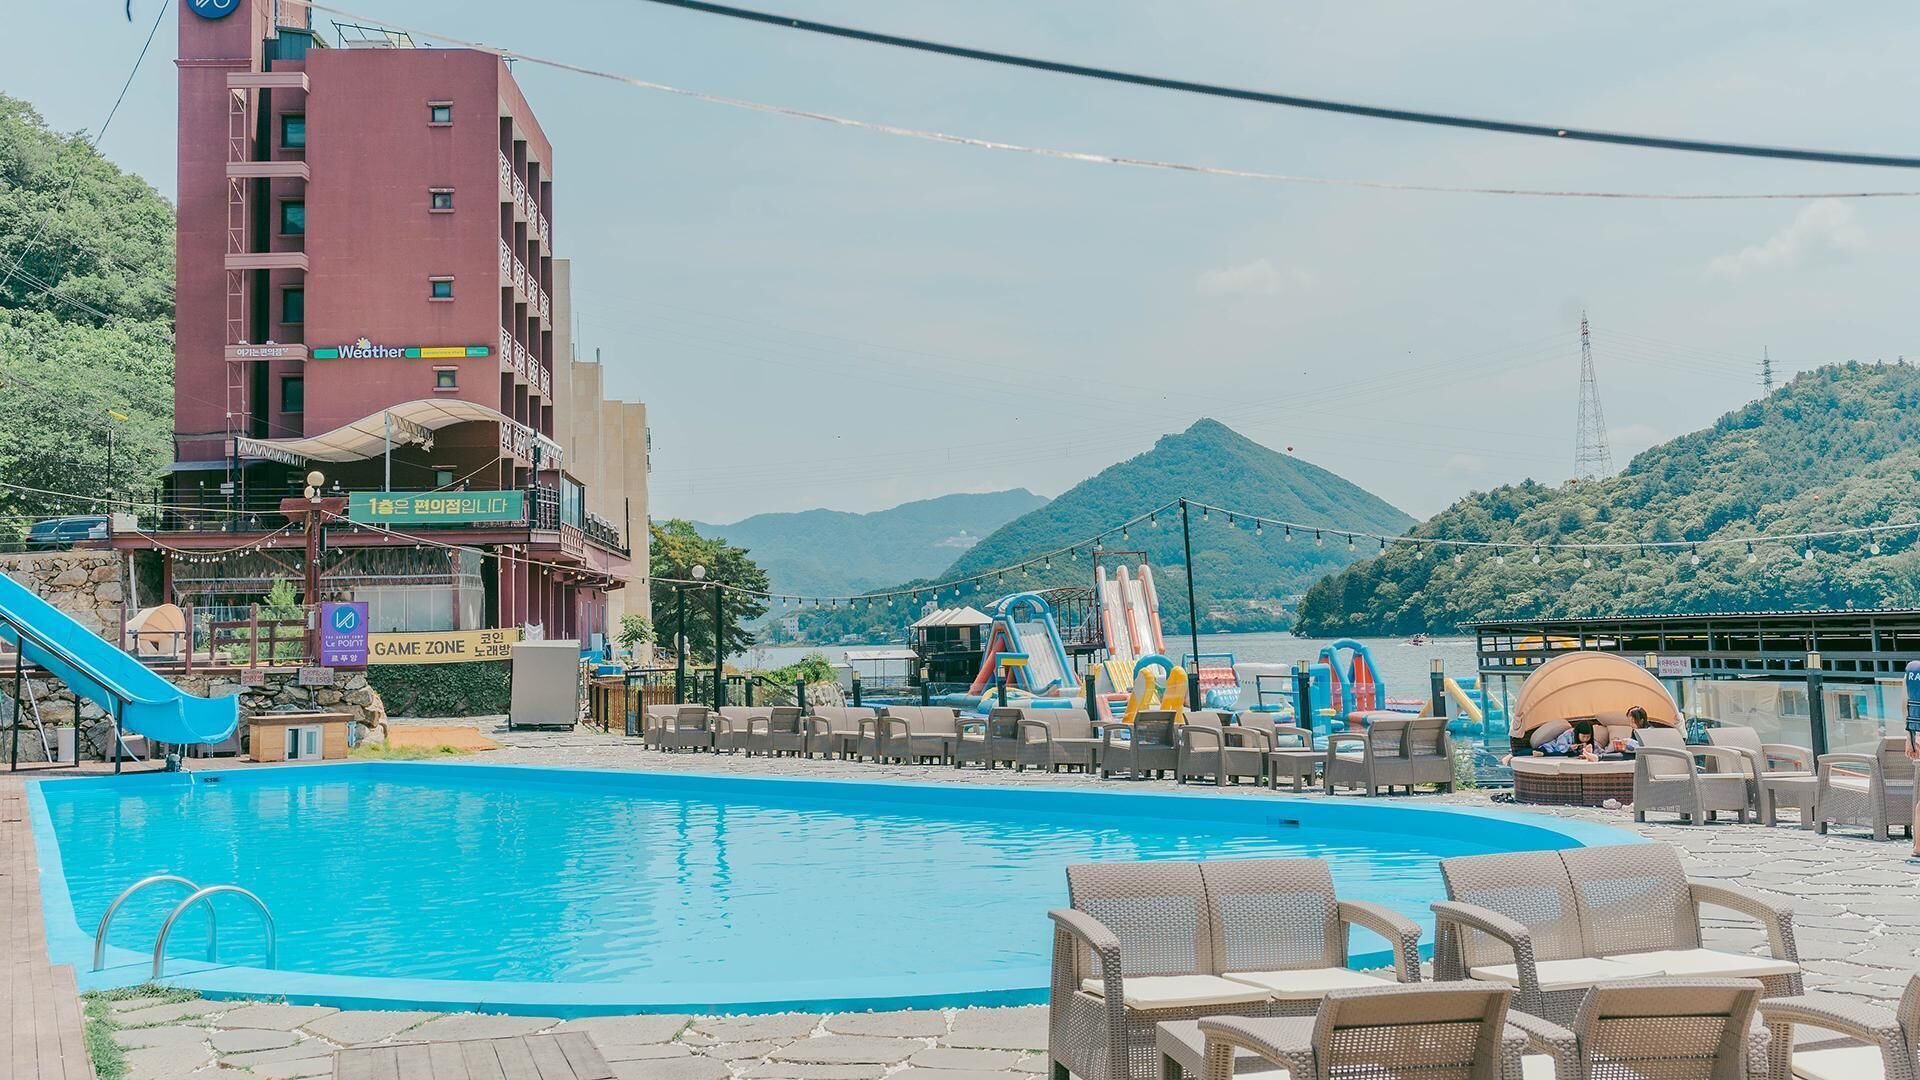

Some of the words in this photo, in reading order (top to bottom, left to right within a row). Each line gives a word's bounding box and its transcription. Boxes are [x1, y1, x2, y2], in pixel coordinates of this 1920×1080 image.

[338, 345, 404, 358] Weather
[369, 498, 409, 514] 1층은
[414, 498, 508, 514] 편의점입니다
[480, 632, 503, 644] 코인
[374, 642, 420, 656] GAME
[425, 640, 465, 655] ZONE
[474, 644, 511, 657] 노래방
